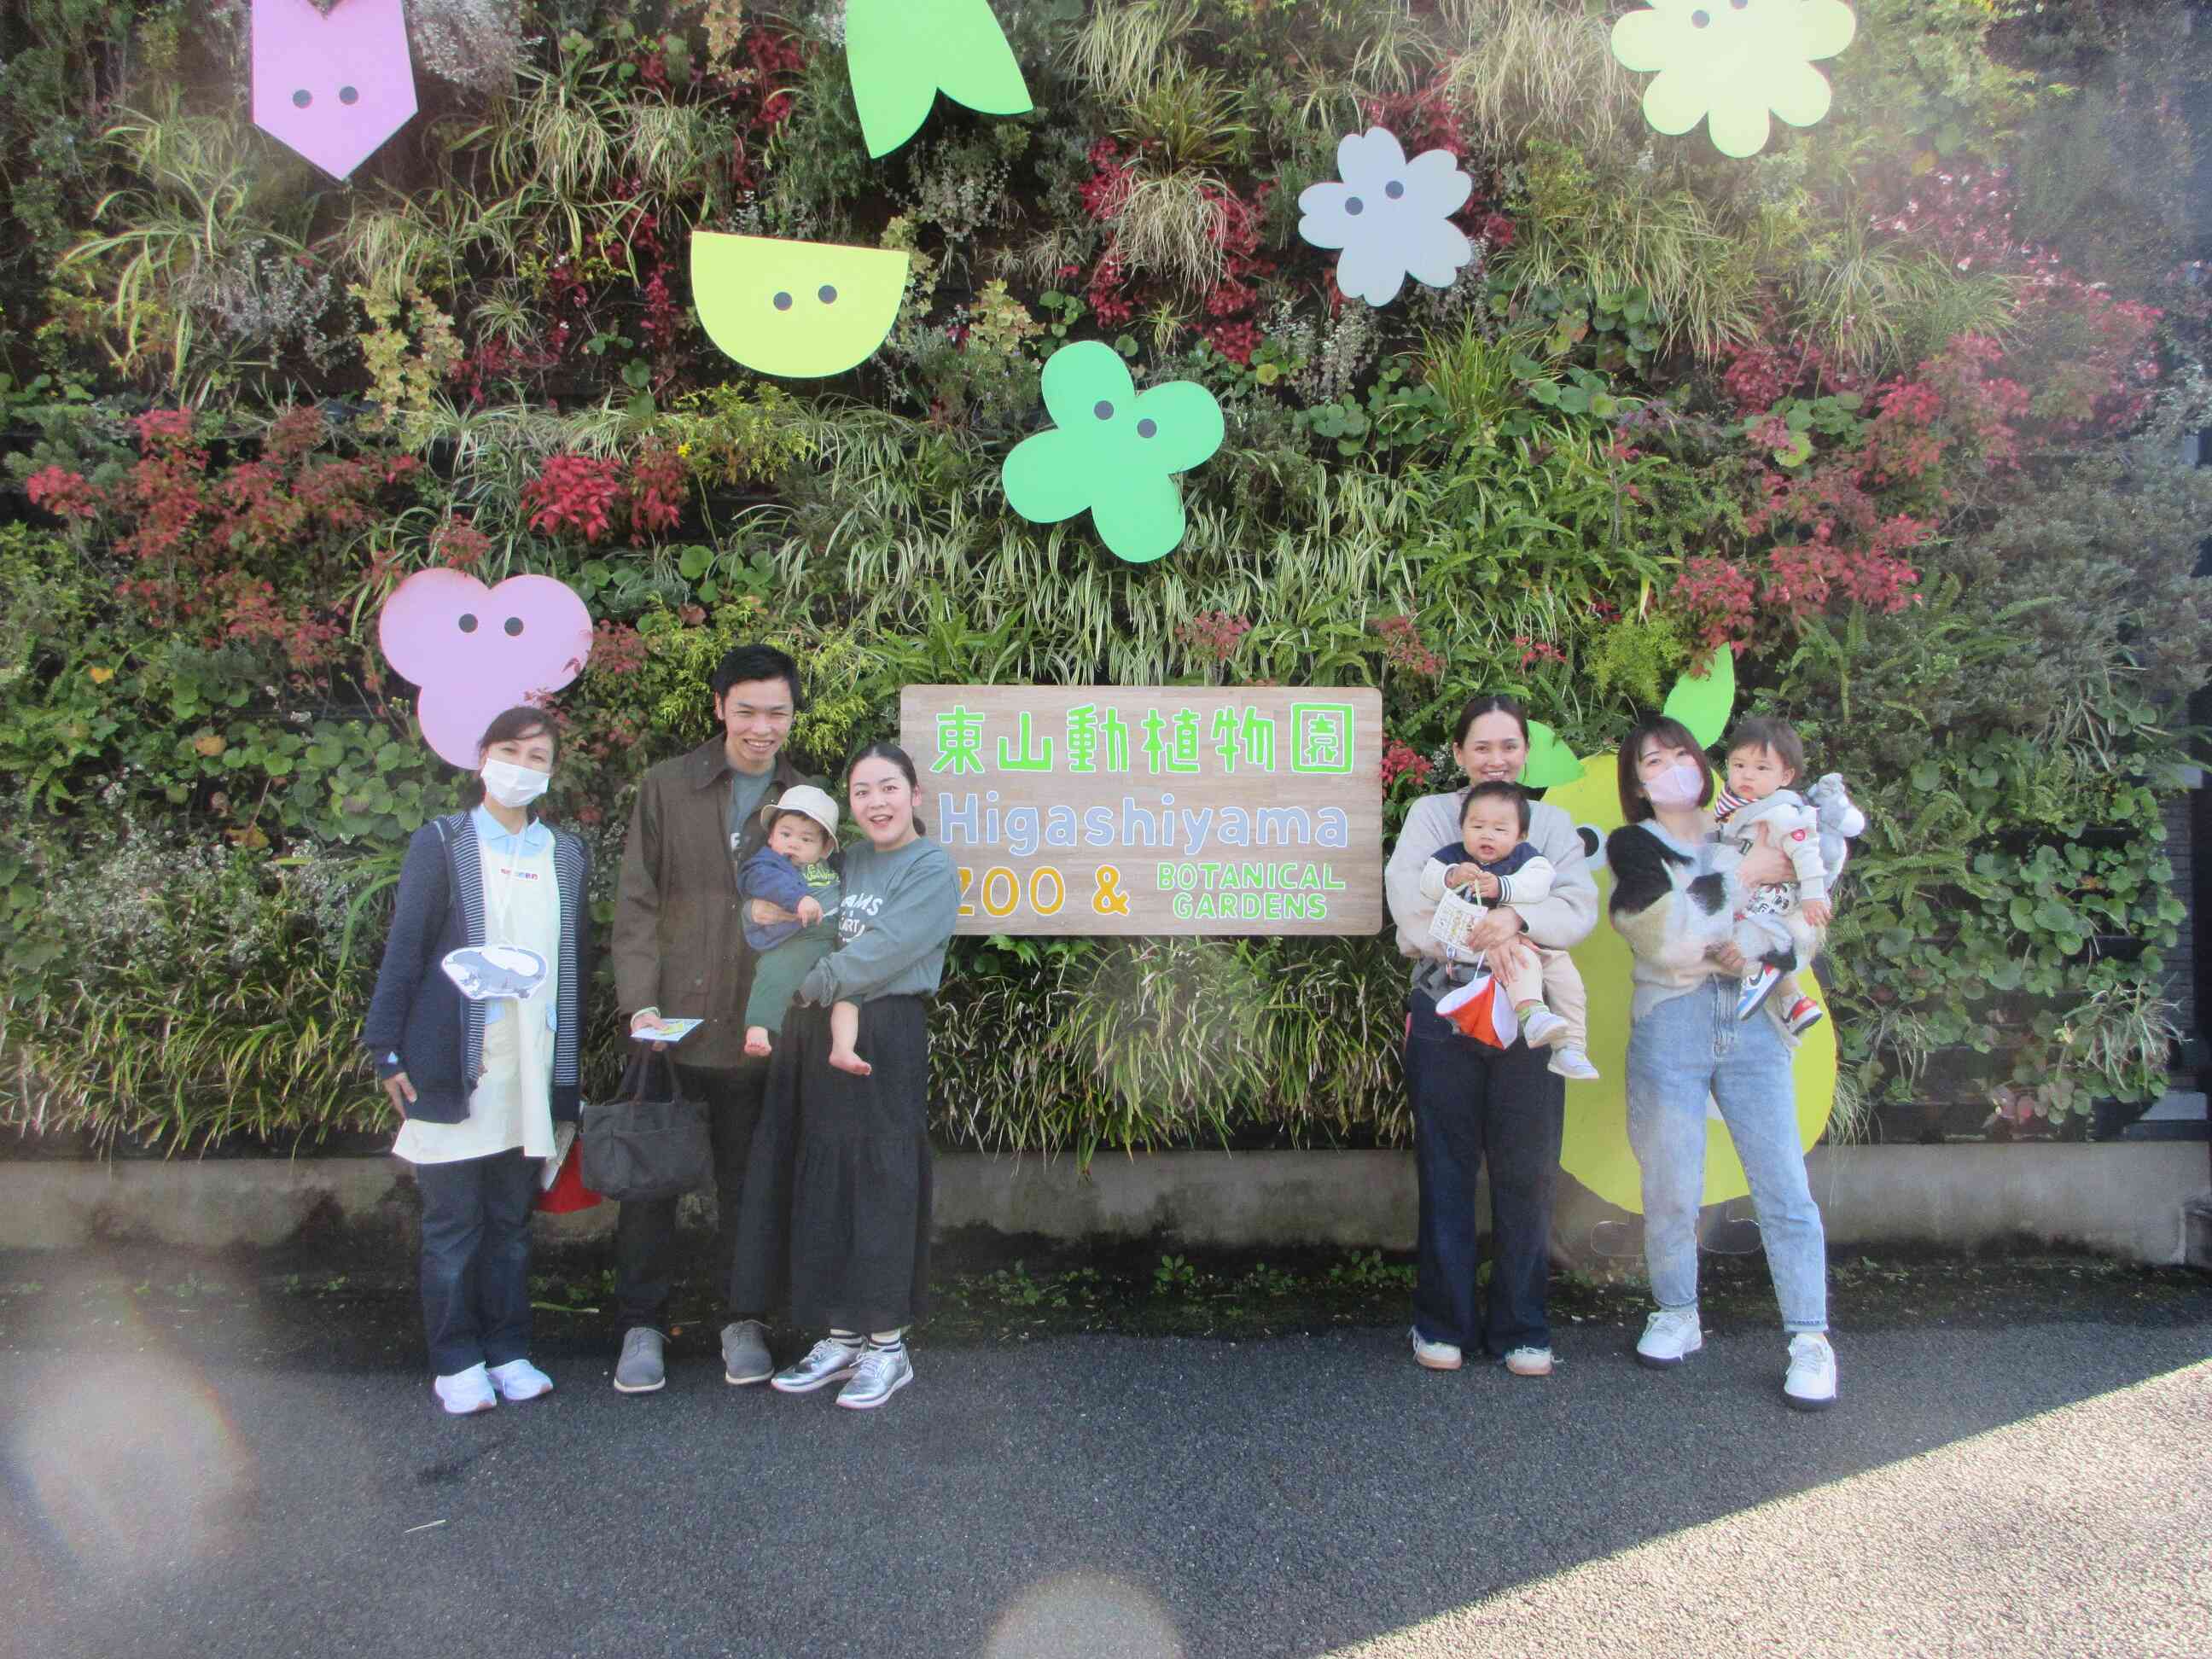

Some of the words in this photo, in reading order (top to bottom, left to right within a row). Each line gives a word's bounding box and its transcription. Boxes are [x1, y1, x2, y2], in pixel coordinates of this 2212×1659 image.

[929, 702, 1354, 775] 東山動植物園
[939, 790, 1348, 856] Higashiyama
[1091, 864, 1130, 917] &
[1156, 862, 1346, 890] BOTANICAL
[1173, 892, 1328, 920] GARDENS
